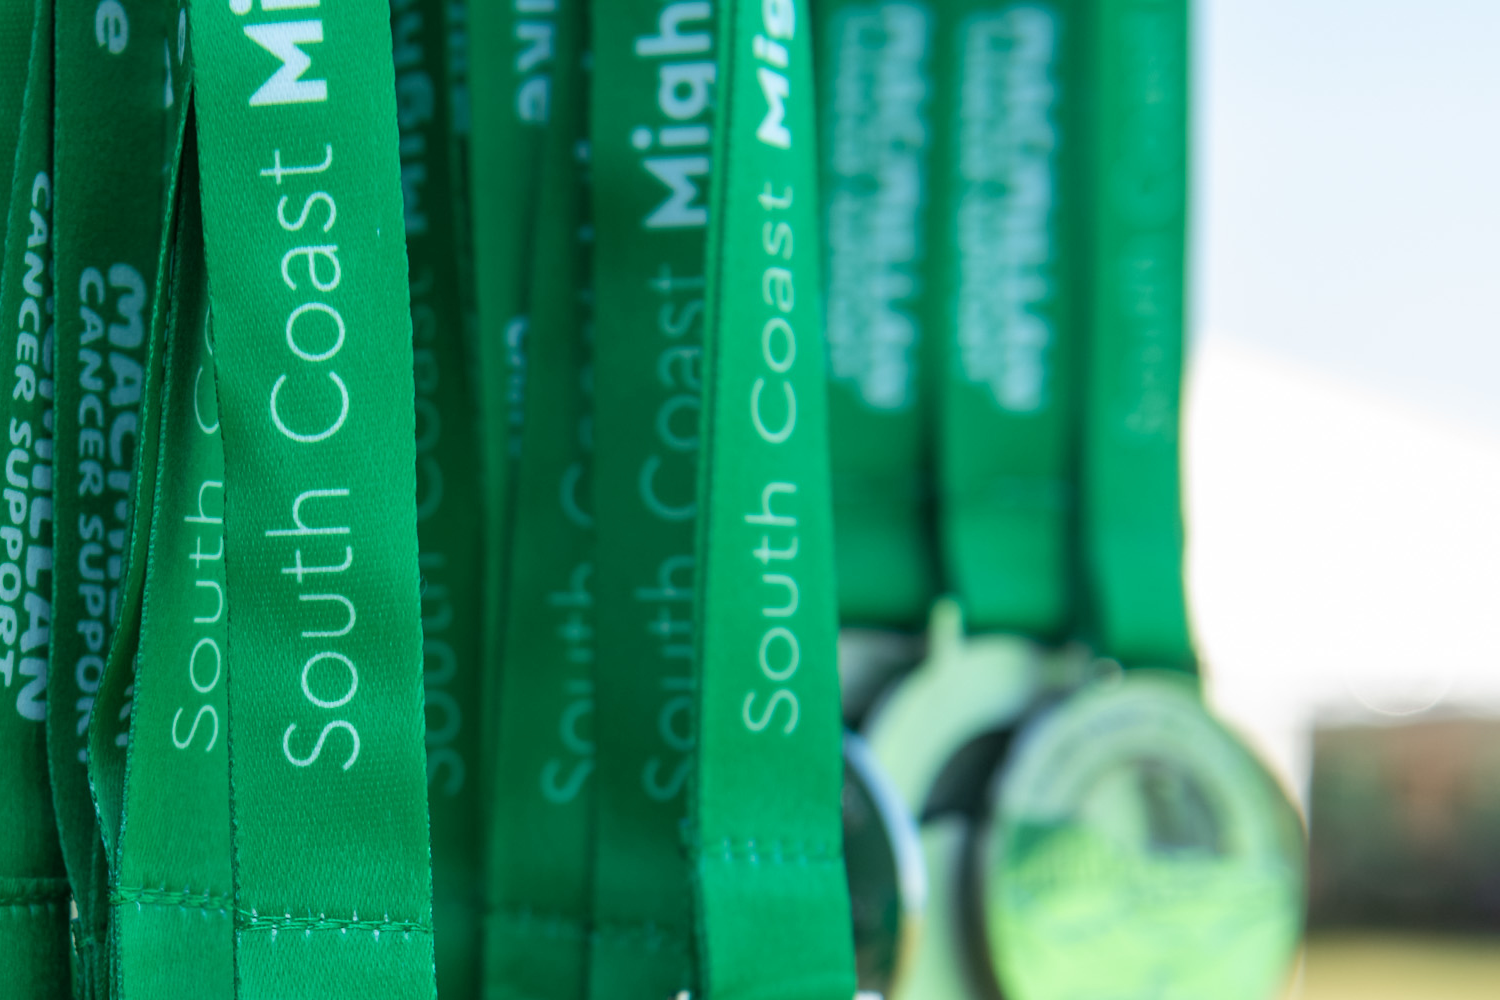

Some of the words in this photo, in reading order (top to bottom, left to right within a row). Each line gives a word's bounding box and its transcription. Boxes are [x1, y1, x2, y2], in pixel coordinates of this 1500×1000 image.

[12, 170, 52, 402] CANCER
[78, 266, 106, 497] CANCER
[258, 142, 349, 443] Coast
[750, 180, 798, 445] Coast
[172, 479, 225, 753] South
[265, 486, 361, 772] South
[742, 479, 802, 736] South
